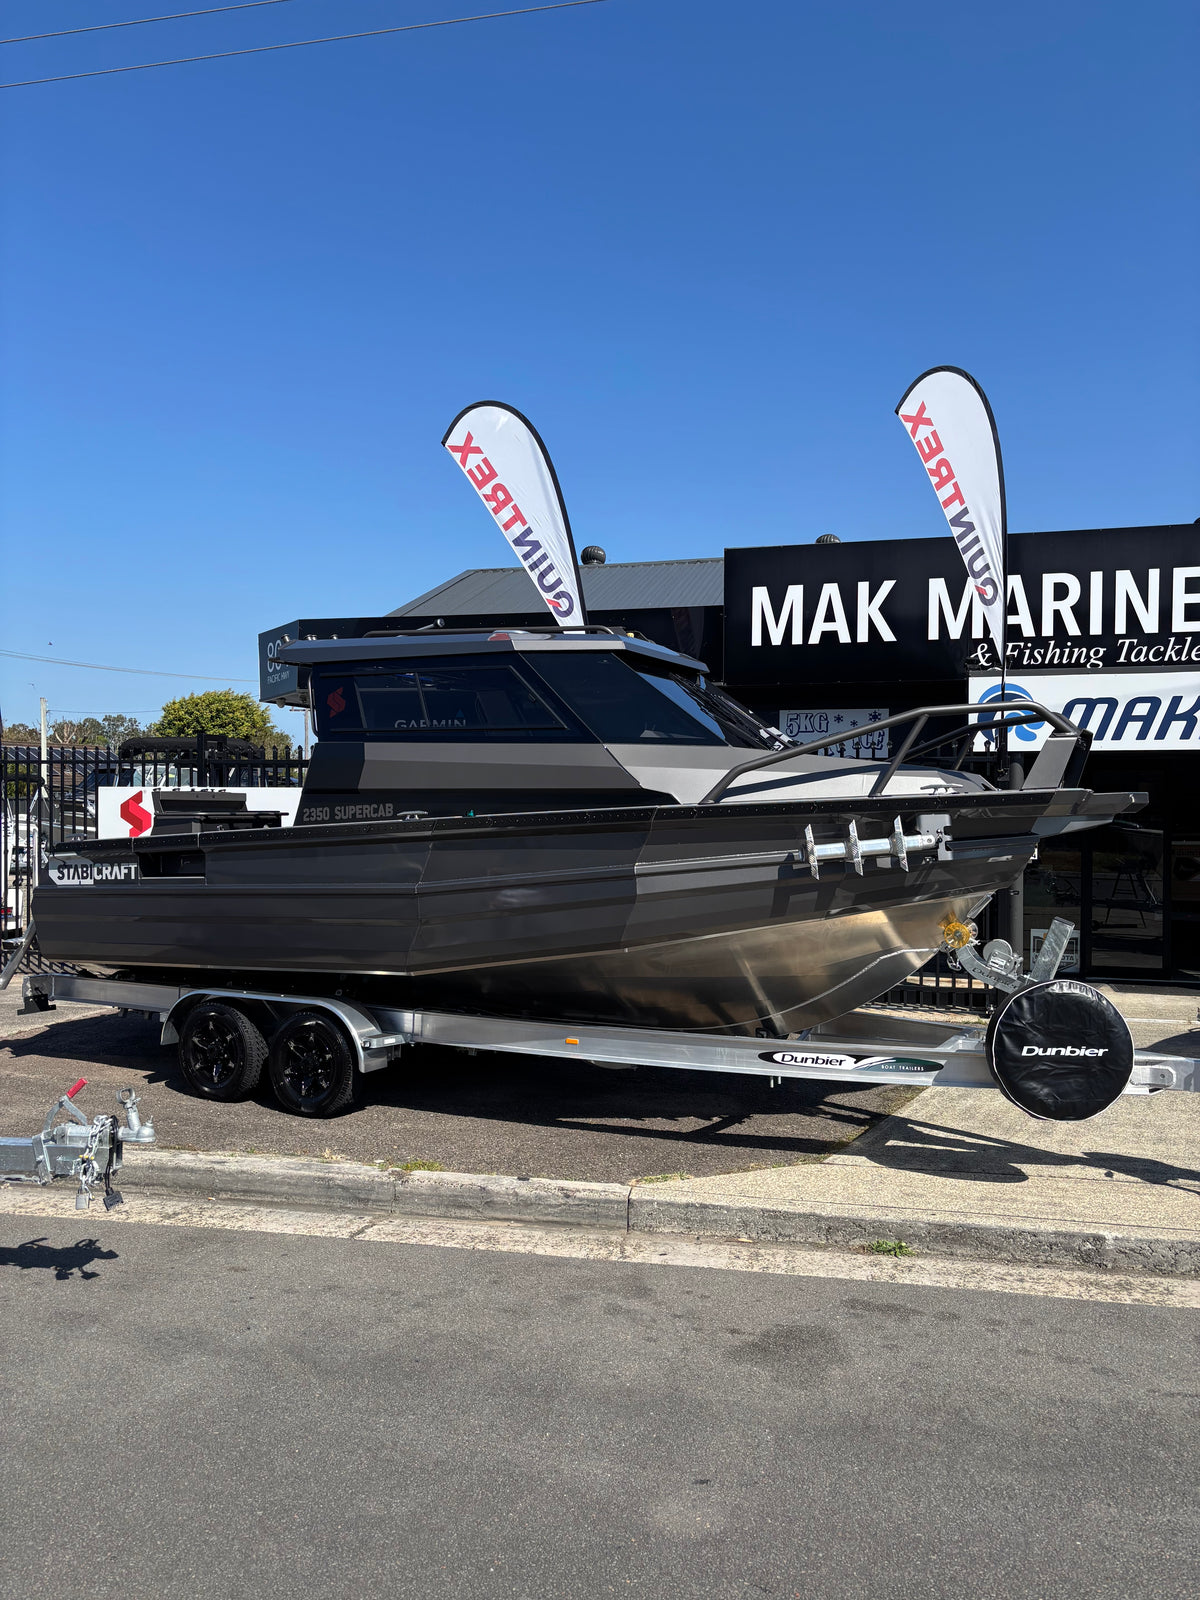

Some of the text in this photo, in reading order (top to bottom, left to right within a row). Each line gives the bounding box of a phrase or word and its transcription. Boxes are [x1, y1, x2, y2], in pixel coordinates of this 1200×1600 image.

[750, 565, 1200, 647] MAK MARINE
[267, 640, 289, 672] 80
[970, 636, 1200, 669] & Fishing Tackle
[394, 719, 467, 729] GARMIN
[786, 711, 830, 738] 5KG
[1061, 695, 1200, 741] MAK
[303, 803, 394, 821] 2350 SUPERCAB
[57, 862, 138, 881] STABICRAFT
[780, 1053, 847, 1067] Dunbier
[1021, 1045, 1109, 1057] Dunbier
